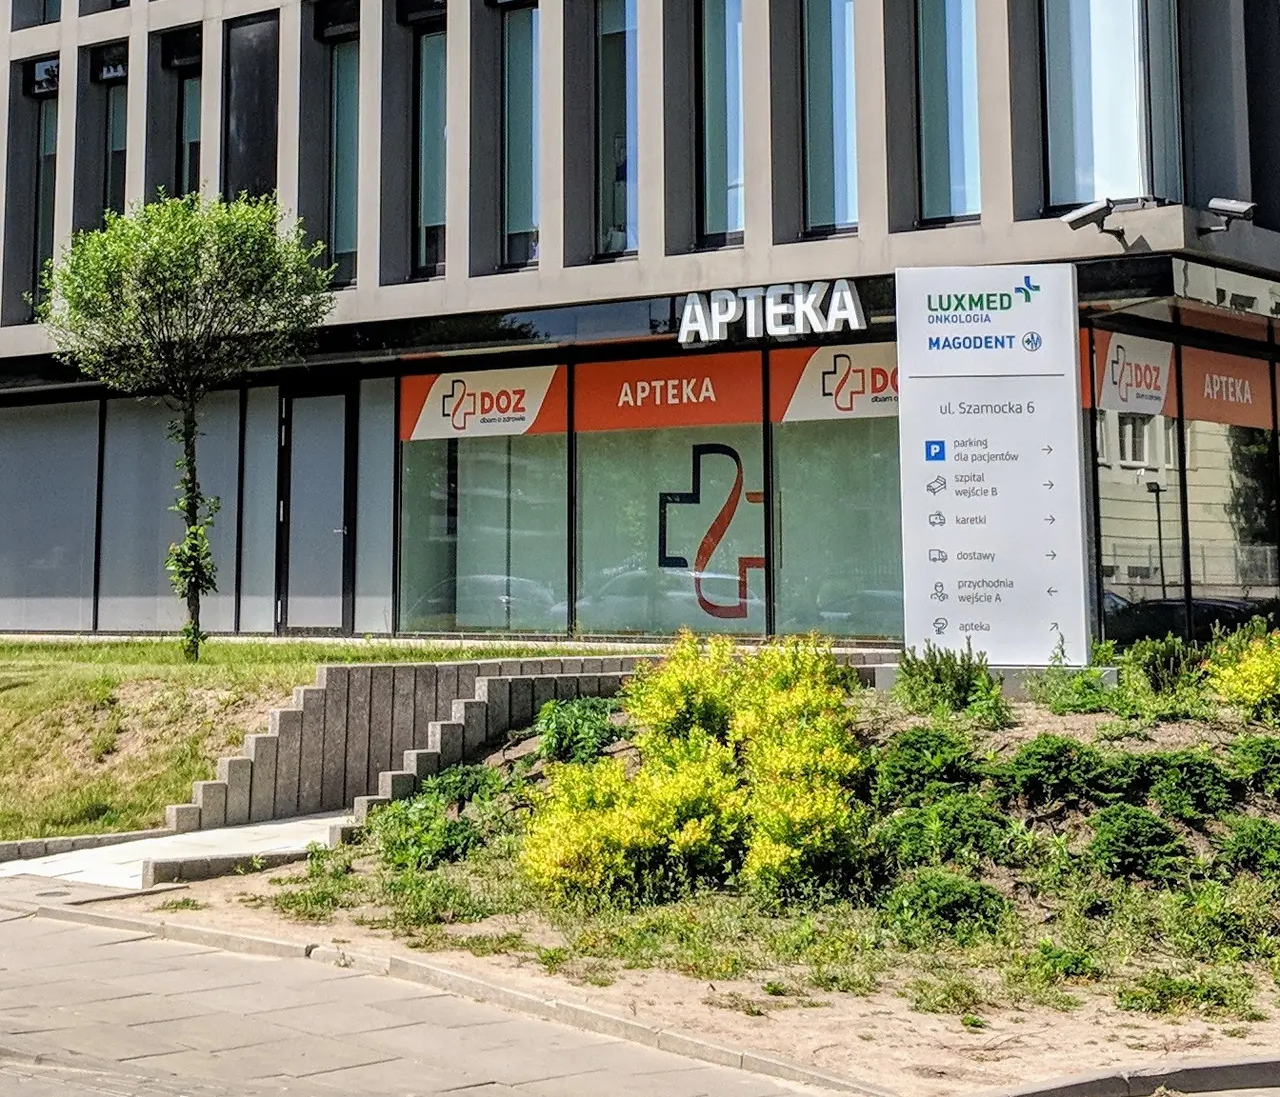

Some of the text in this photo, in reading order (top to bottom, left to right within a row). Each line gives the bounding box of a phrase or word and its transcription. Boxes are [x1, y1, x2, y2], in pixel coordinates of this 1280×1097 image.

[927, 293, 1012, 312] LUXMED
[678, 279, 867, 344] APTEKA
[927, 313, 992, 324] ONKOLOGIA
[928, 335, 1015, 350] MAGODENT
[1134, 363, 1161, 391] DOZ
[618, 377, 717, 407] APTEKA
[1203, 373, 1253, 404] APTEKA
[480, 389, 526, 415] DOZ
[939, 401, 1036, 415] ul. Szamocka 6
[953, 437, 988, 449] parking
[930, 444, 940, 457] P
[954, 451, 1019, 463] dla pacjentów
[954, 473, 985, 484] szpital
[955, 486, 998, 498] wejście B
[955, 515, 987, 525] karetki
[956, 551, 996, 563] dostawy
[957, 578, 1014, 590] przychodnia
[958, 592, 1002, 605] wejście A
[959, 621, 991, 632] apteka
